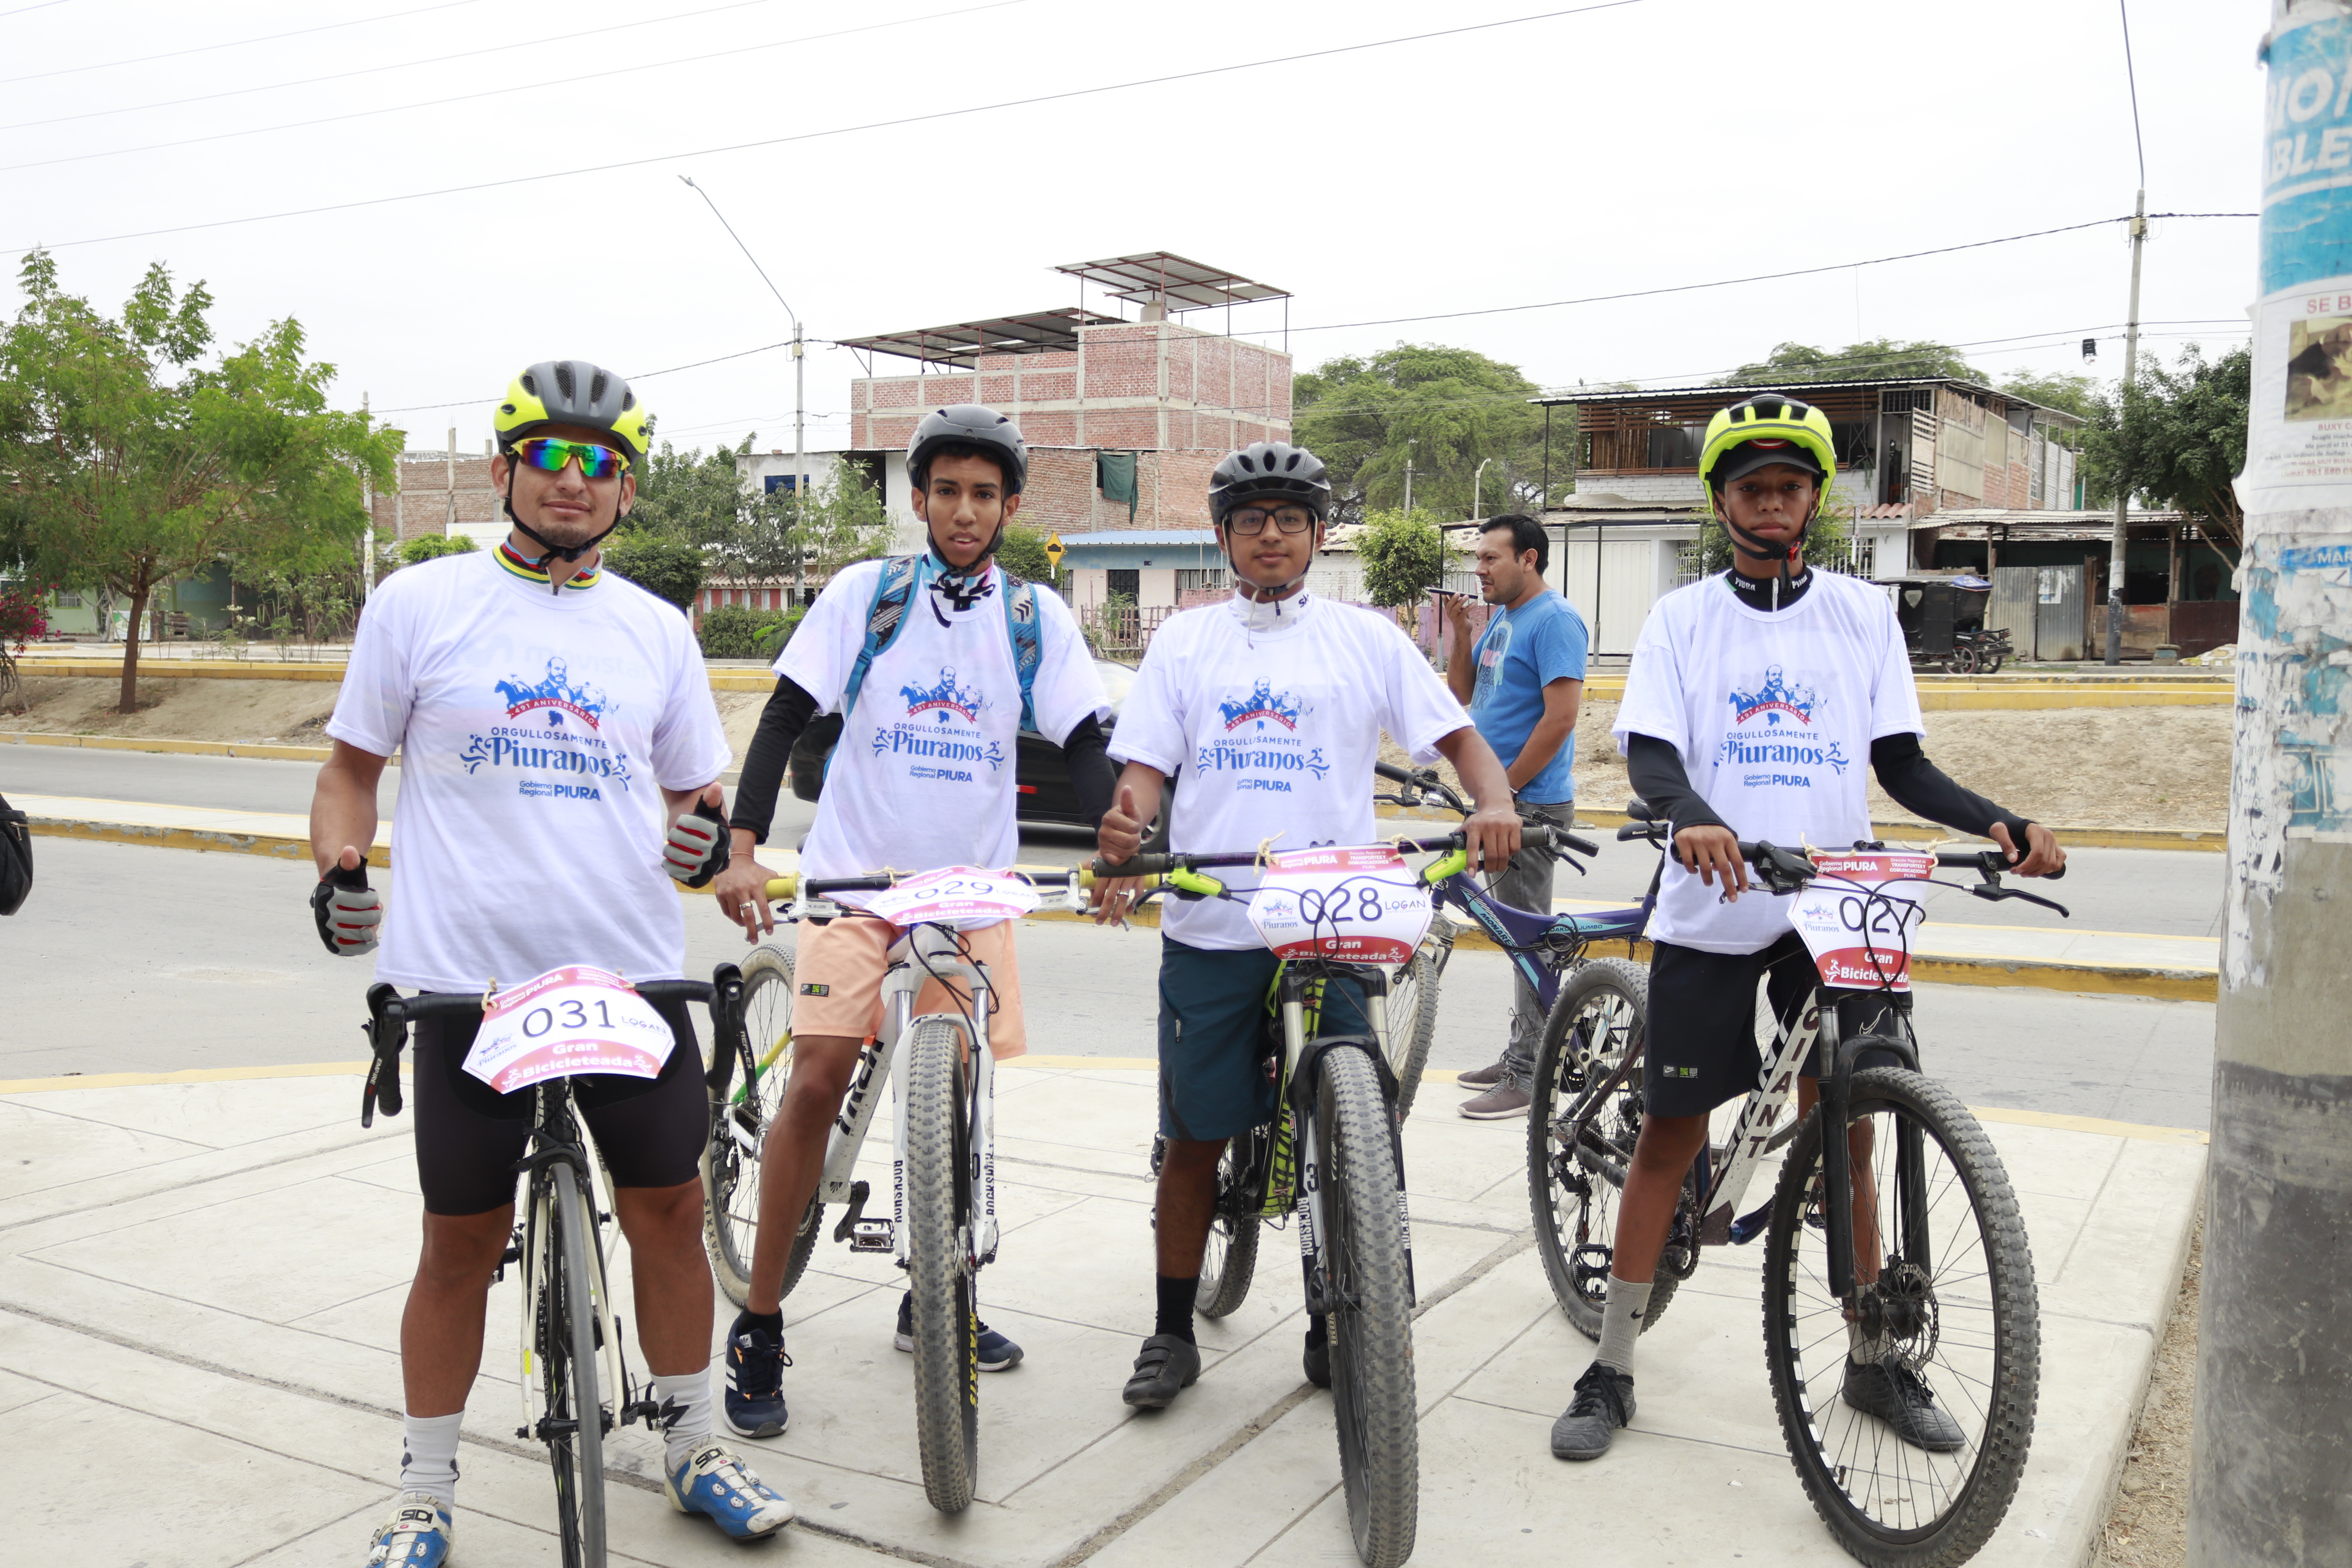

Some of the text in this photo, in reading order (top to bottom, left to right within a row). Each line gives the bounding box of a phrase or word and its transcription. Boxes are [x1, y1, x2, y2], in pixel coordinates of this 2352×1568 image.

[2307, 297, 2330, 314] SE
[515, 700, 595, 724] 491 ANIVERSARIO
[913, 702, 972, 720] 491 ANIVERSARIO
[1231, 710, 1292, 728] 491 ANIVERSARIO
[1740, 702, 1805, 721] 491 ANIVERSARIO
[491, 727, 608, 750] ORGULLOSAMENTE
[894, 722, 981, 739] ORGULLOSAMENTE
[1726, 730, 1818, 740] ORGULLOSAMENTE
[887, 730, 983, 762] Piuranos
[1722, 740, 1824, 766] Piuranos
[485, 737, 611, 778] Piuranos
[519, 780, 552, 789] Gobierno
[909, 769, 973, 782] Regional PIURA
[1744, 774, 1811, 788] Regional PIURA
[519, 784, 601, 801] Regional PIURA
[1253, 779, 1292, 792] PIURA
[1304, 855, 1338, 866] PIURA
[1843, 862, 1878, 871] PIURA
[914, 880, 994, 900] 029
[914, 908, 1001, 919] Bicicleteada
[1299, 887, 1383, 925] 028
[1385, 900, 1426, 911] LOGAN
[1261, 921, 1298, 929] Piuranos
[1839, 896, 1916, 936] 027
[1803, 923, 1839, 933] Piuranos
[1325, 940, 1362, 949] Gran
[1864, 951, 1893, 964] Gran
[499, 991, 525, 1006] Gobierno
[500, 974, 564, 1010] Regional PIURA
[522, 1000, 616, 1038] 031
[621, 1016, 666, 1034] LOGAN
[552, 1043, 598, 1054] Gran
[740, 1031, 753, 1070] REFLEX
[370, 1058, 383, 1085] EMPIRE
[522, 1056, 633, 1079] Bicicleteada
[1747, 1006, 1819, 1159] GIANT
[704, 1198, 723, 1262] MAXXIS
[1297, 1196, 1314, 1257] ROCKSHOX
